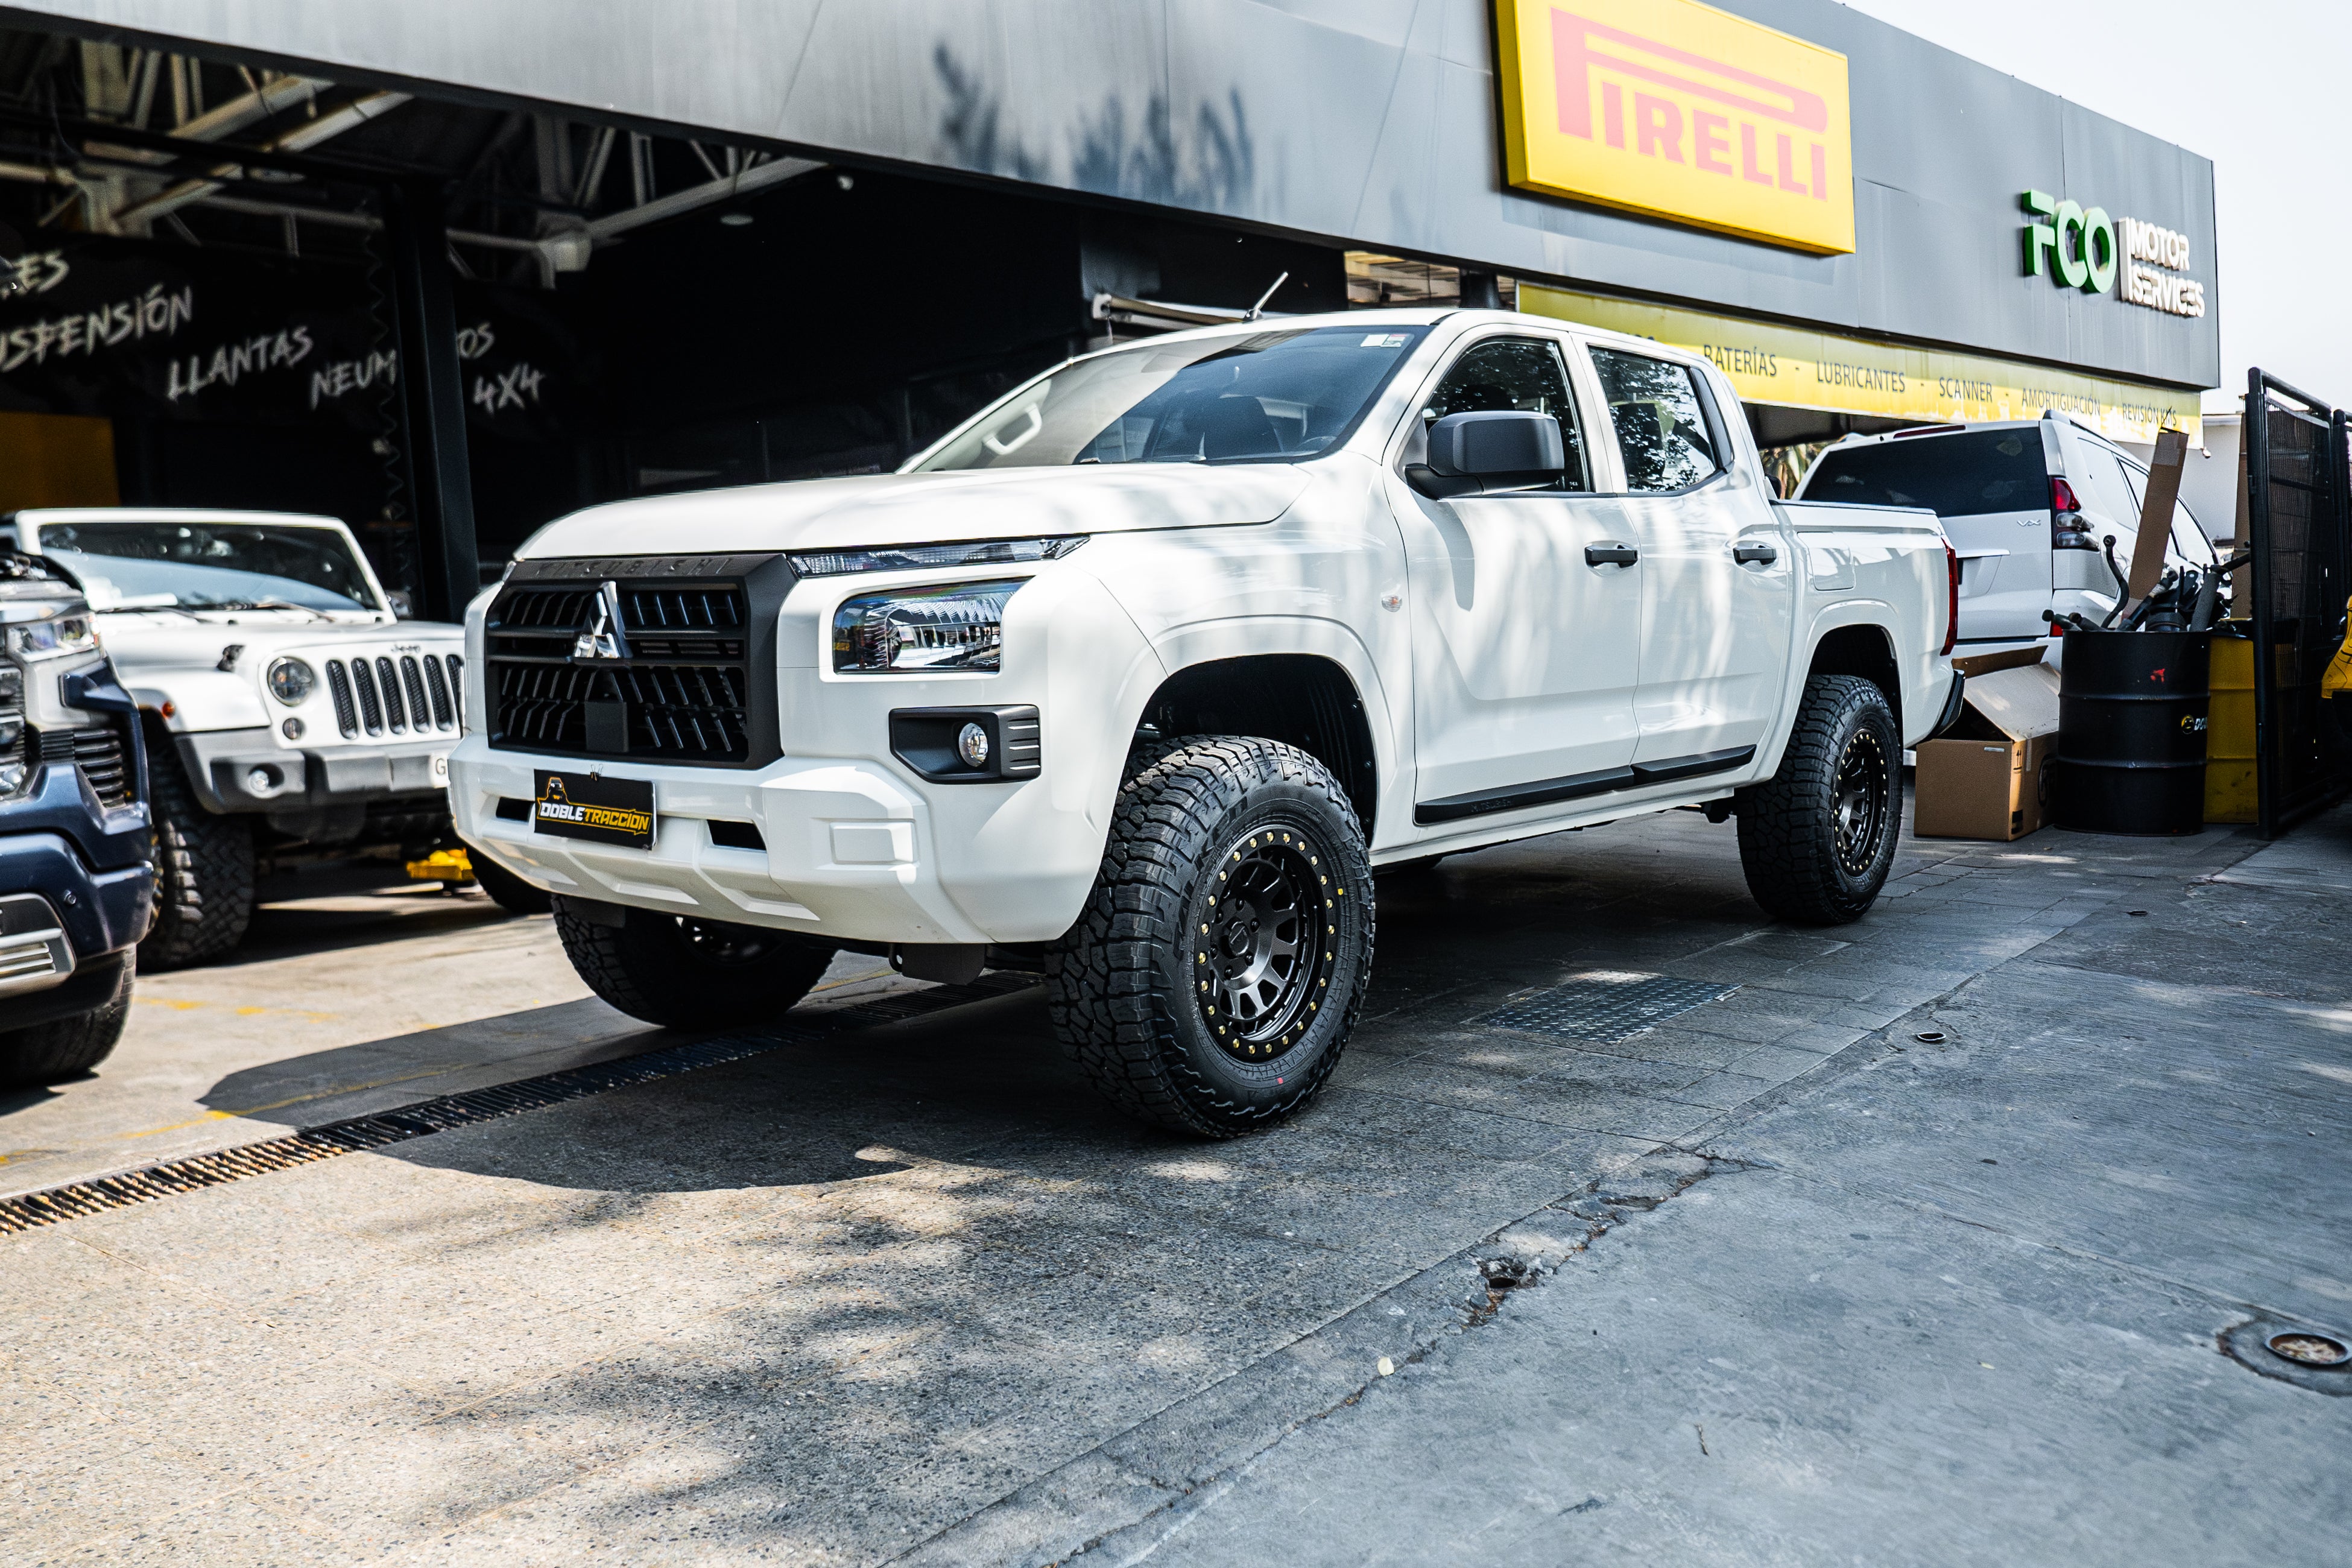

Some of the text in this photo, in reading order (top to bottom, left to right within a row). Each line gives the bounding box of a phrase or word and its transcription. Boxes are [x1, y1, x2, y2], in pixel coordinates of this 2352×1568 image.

[1550, 7, 1828, 201] PIRELLI
[2022, 188, 2117, 294] FCO
[2129, 217, 2190, 271] MOTOR
[2131, 263, 2205, 318] SERVICES
[168, 324, 314, 403] LLANTAS
[474, 362, 545, 415] 4X4
[1704, 344, 1777, 378] BATERÍAS
[1816, 359, 1906, 394] LUBRICANTES
[1938, 376, 1993, 403] SCANNER
[2022, 387, 2101, 417] AMORTIGUACIÓN
[2122, 402, 2159, 425] REVISIÓN
